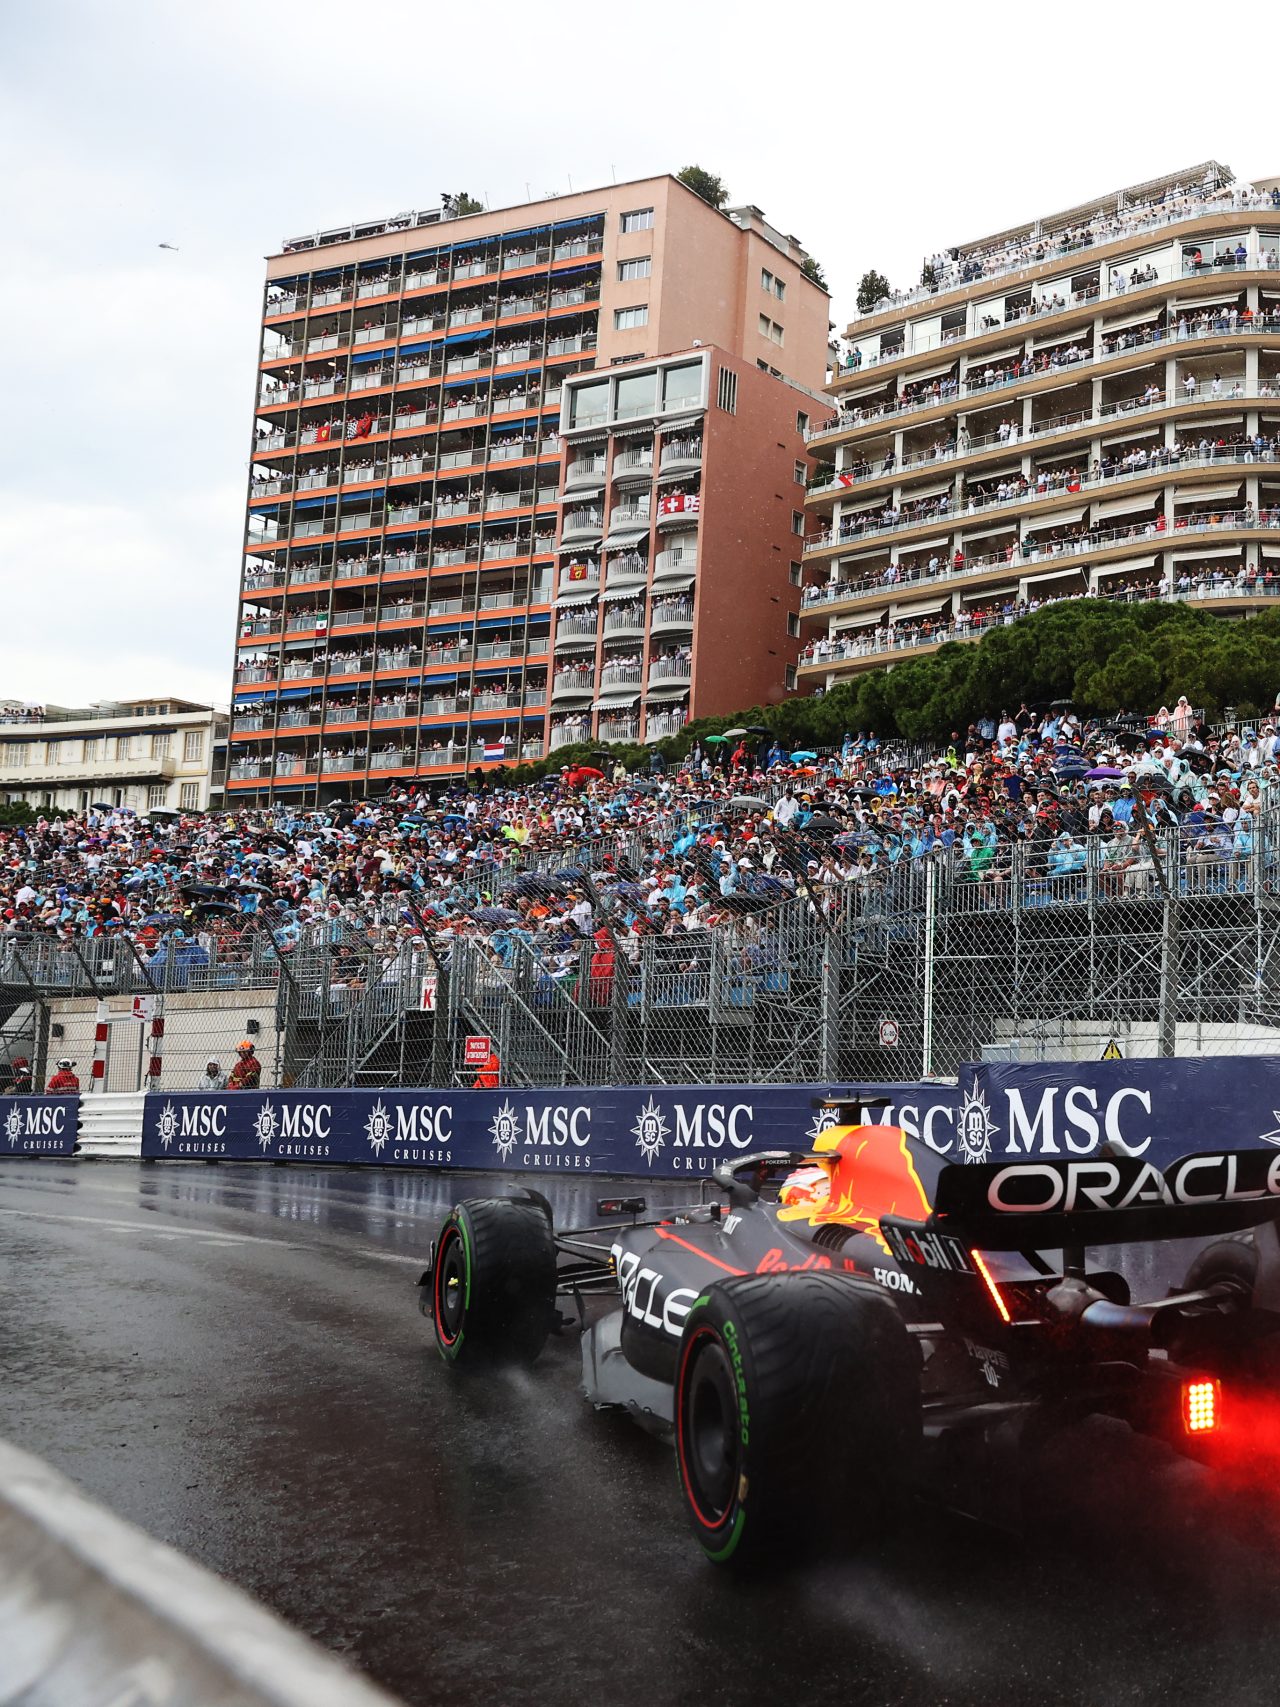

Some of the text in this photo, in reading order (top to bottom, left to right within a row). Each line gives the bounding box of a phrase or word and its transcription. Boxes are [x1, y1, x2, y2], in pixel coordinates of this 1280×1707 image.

[423, 988, 434, 1009] K
[24, 1106, 67, 1135] MSC
[180, 1105, 227, 1137] MSC
[280, 1104, 332, 1138] MSC
[395, 1105, 453, 1143] MSC
[523, 1106, 591, 1147] MSC
[673, 1104, 753, 1148] MSC
[861, 1105, 954, 1155] MSC
[1005, 1086, 1152, 1158] MSC
[24, 1140, 63, 1149] CRUISES
[179, 1143, 225, 1152] CRUISES
[279, 1144, 329, 1156] CRUISES
[395, 1149, 452, 1162] CRUISES
[524, 1154, 591, 1168] CRUISES
[673, 1157, 728, 1171] CRUIS
[882, 1224, 968, 1271] Mobil 1
[874, 1267, 923, 1296] HON
[722, 1319, 749, 1445] Cinturato
